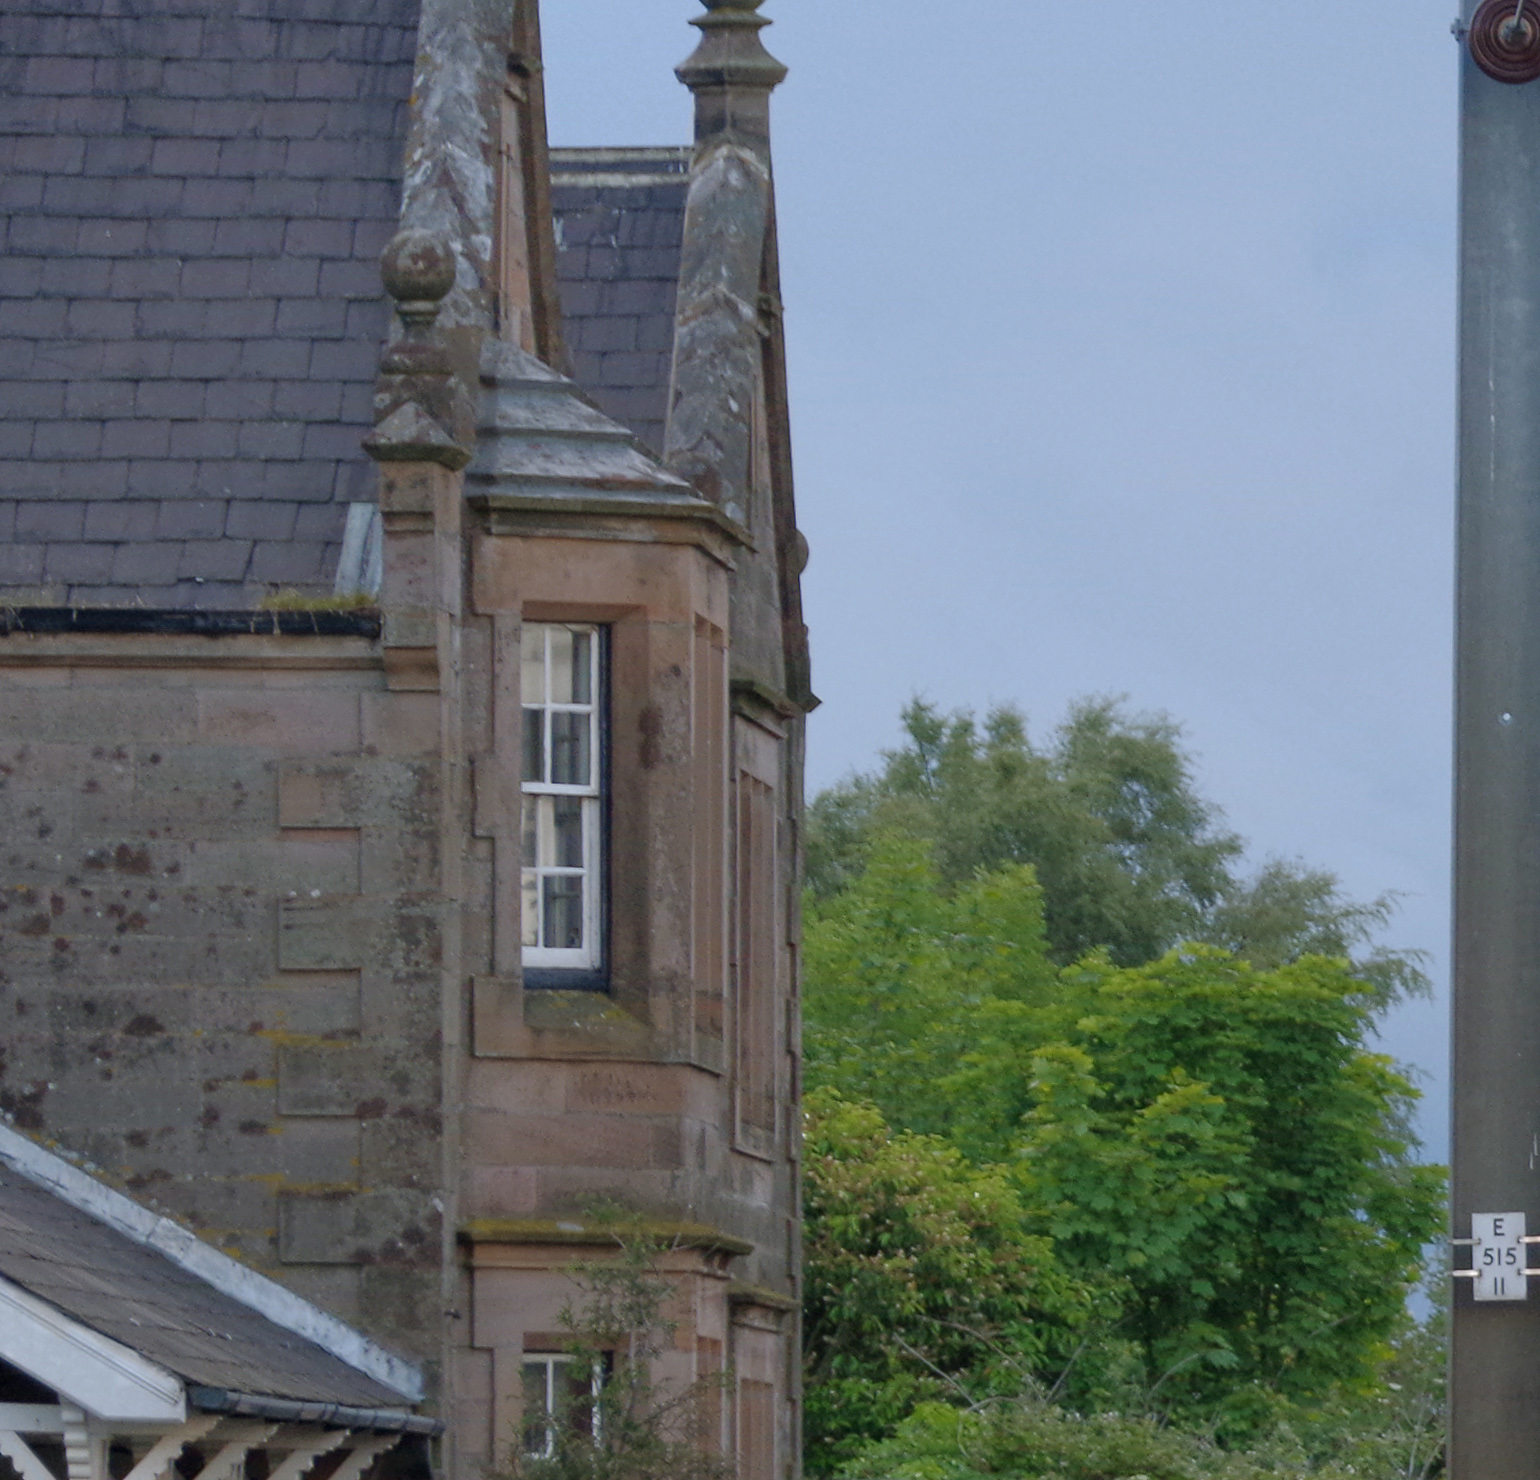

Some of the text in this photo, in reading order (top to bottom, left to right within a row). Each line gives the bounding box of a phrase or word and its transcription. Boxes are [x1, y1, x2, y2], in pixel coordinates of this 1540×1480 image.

[1493, 1217, 1505, 1237] E
[1483, 1247, 1517, 1266] 515
[1494, 1276, 1505, 1296] 11
